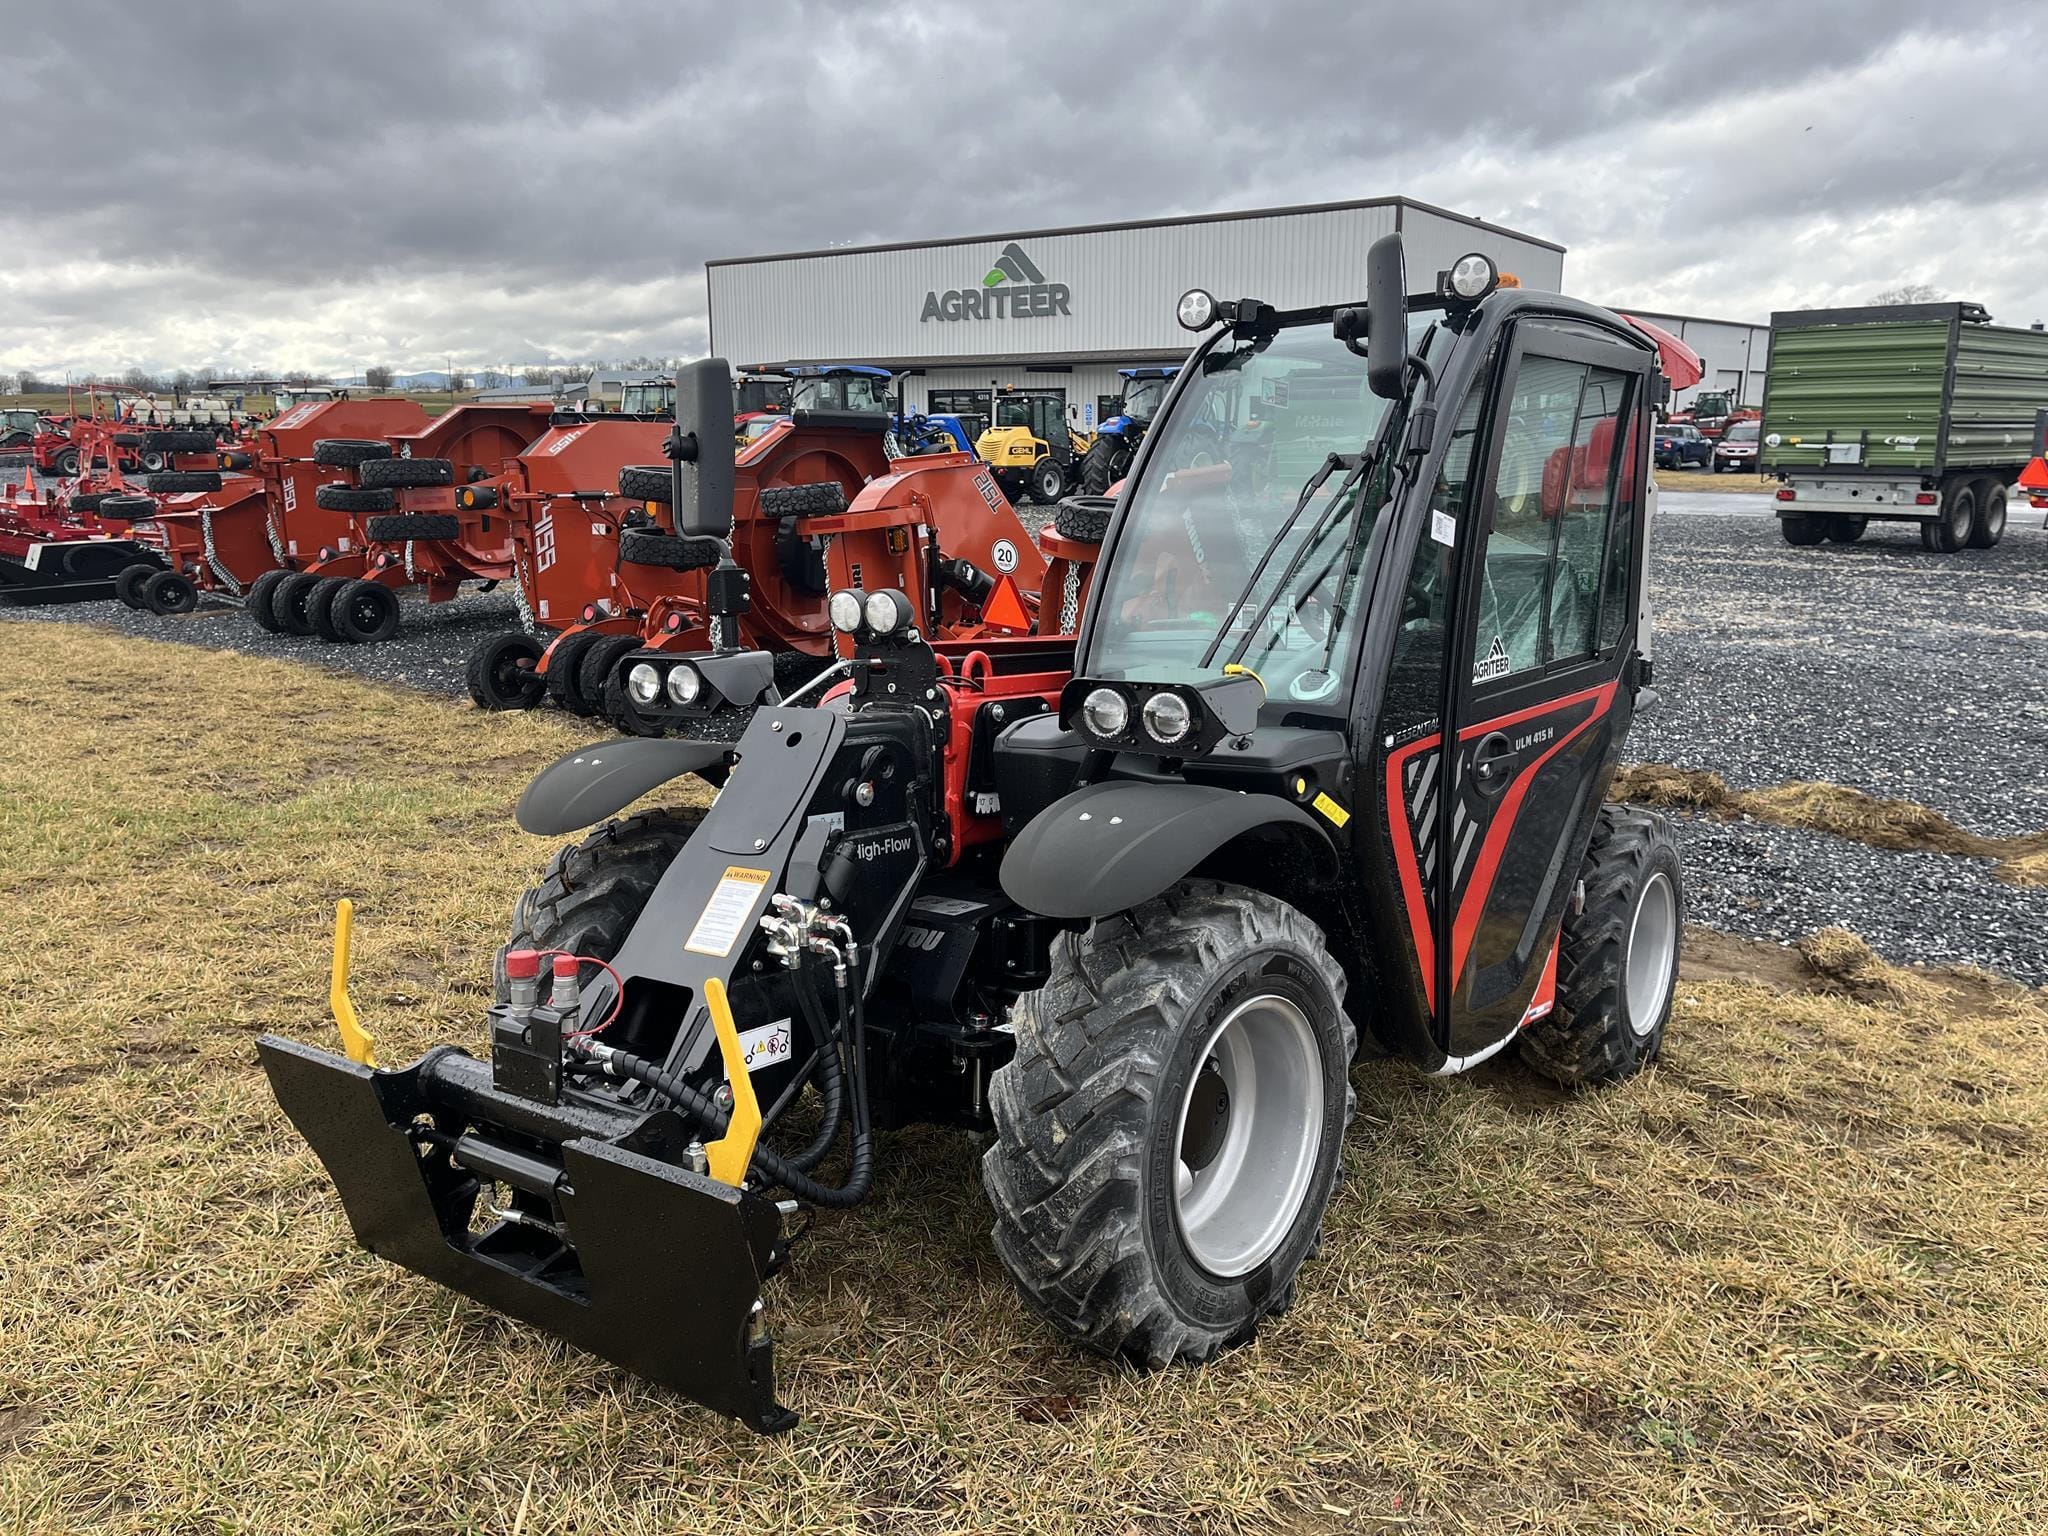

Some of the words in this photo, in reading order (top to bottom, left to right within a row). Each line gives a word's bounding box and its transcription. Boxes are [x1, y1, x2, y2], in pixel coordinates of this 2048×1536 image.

[920, 283, 1073, 322] AGRITEER
[273, 404, 323, 429] 3150
[548, 430, 582, 456] 4155
[1011, 446, 1033, 455] GEHL
[283, 476, 297, 513] 3150
[534, 500, 556, 574] 4155
[997, 548, 1013, 563] 20
[1472, 657, 1510, 680] AGRITEER
[1515, 734, 1532, 751] ULM
[1533, 728, 1547, 744] 415
[1547, 727, 1554, 740] H
[733, 871, 767, 882] WARNING
[897, 925, 946, 951] TOU
